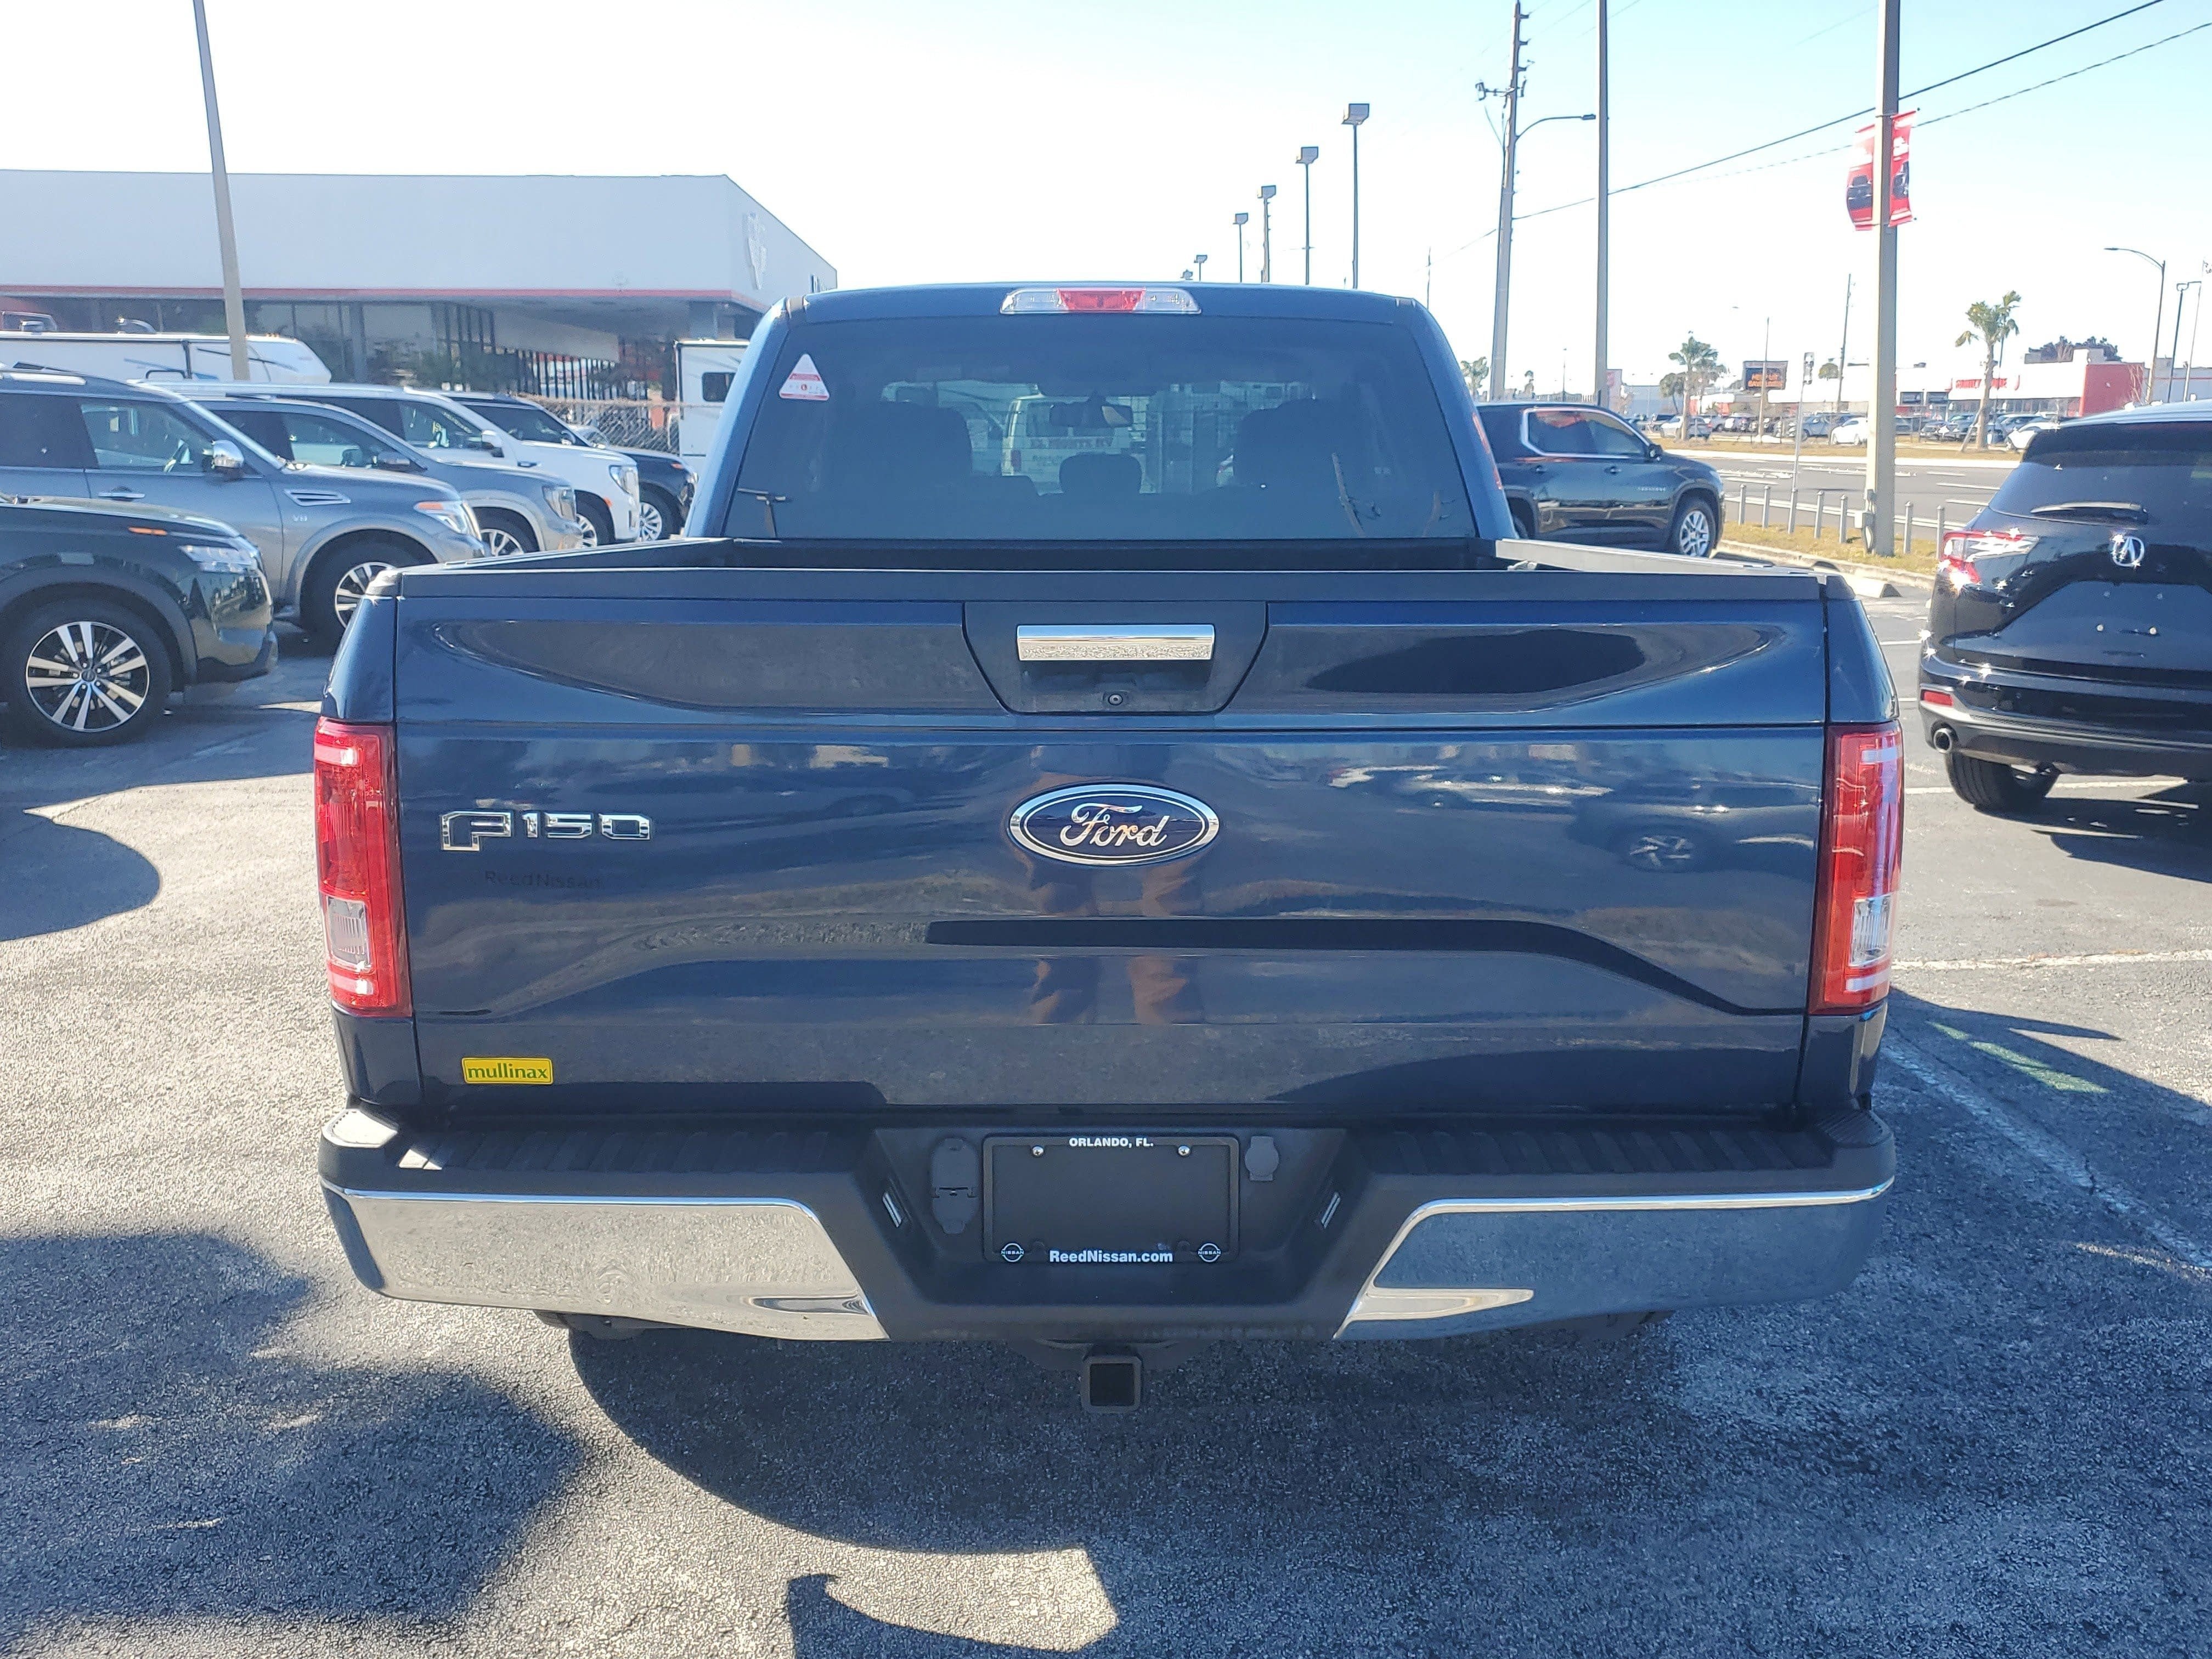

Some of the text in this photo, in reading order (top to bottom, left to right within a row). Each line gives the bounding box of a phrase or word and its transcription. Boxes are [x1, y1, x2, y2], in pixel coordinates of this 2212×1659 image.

[1059, 802, 1171, 847] Ford
[467, 1062, 549, 1079] mullinax
[1069, 1137, 1154, 1148] ORLANDO, FL.
[1049, 1249, 1173, 1263] ReedNissan.com
